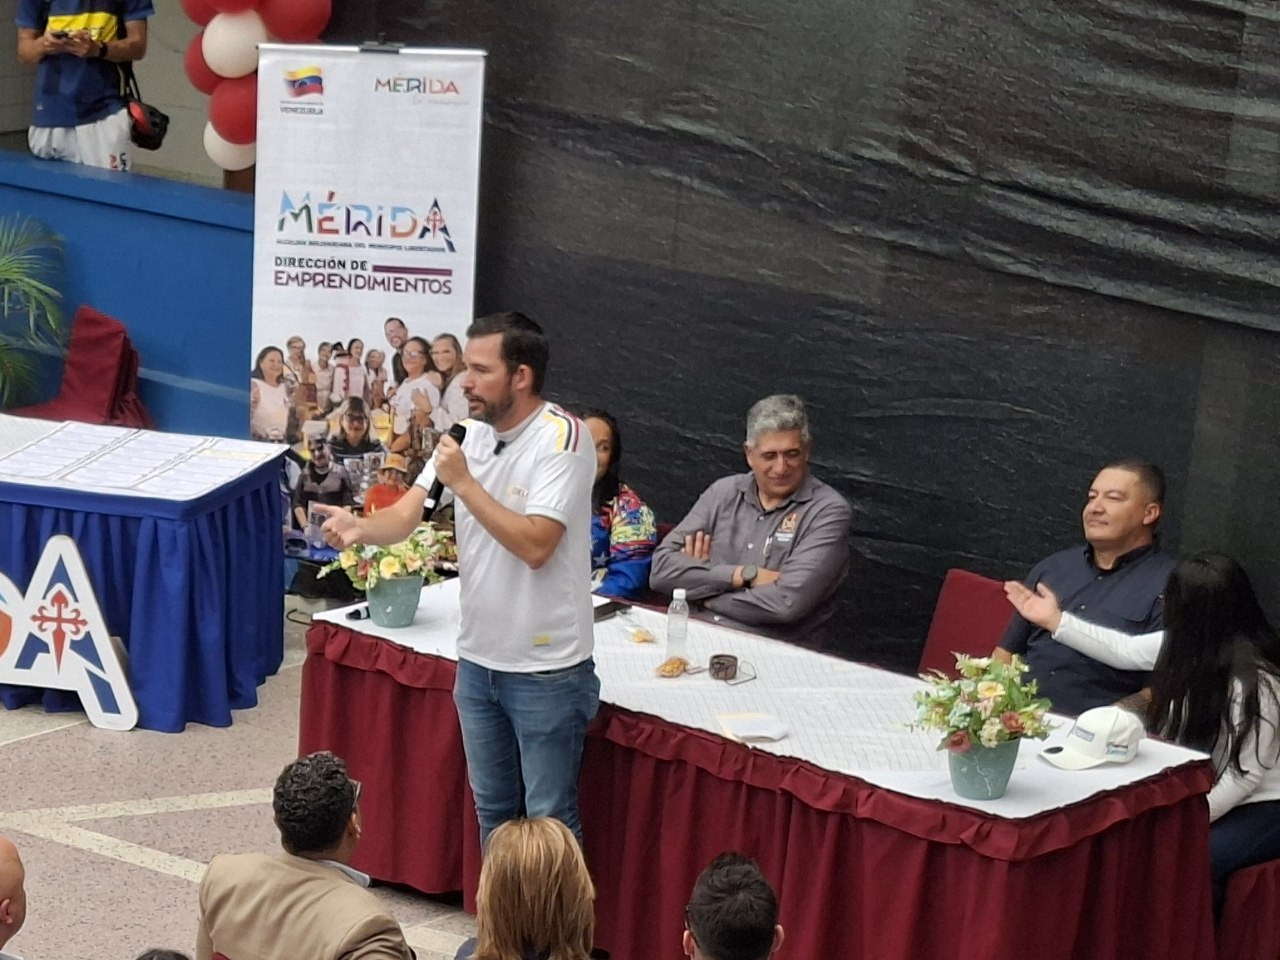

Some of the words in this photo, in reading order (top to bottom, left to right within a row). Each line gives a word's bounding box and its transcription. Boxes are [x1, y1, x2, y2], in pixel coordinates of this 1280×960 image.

[277, 190, 457, 253] MÉRIDA
[274, 255, 347, 270] DIRECCIÓN
[350, 260, 369, 272] DE
[274, 270, 453, 295] EMPRENDIMIENTOS
